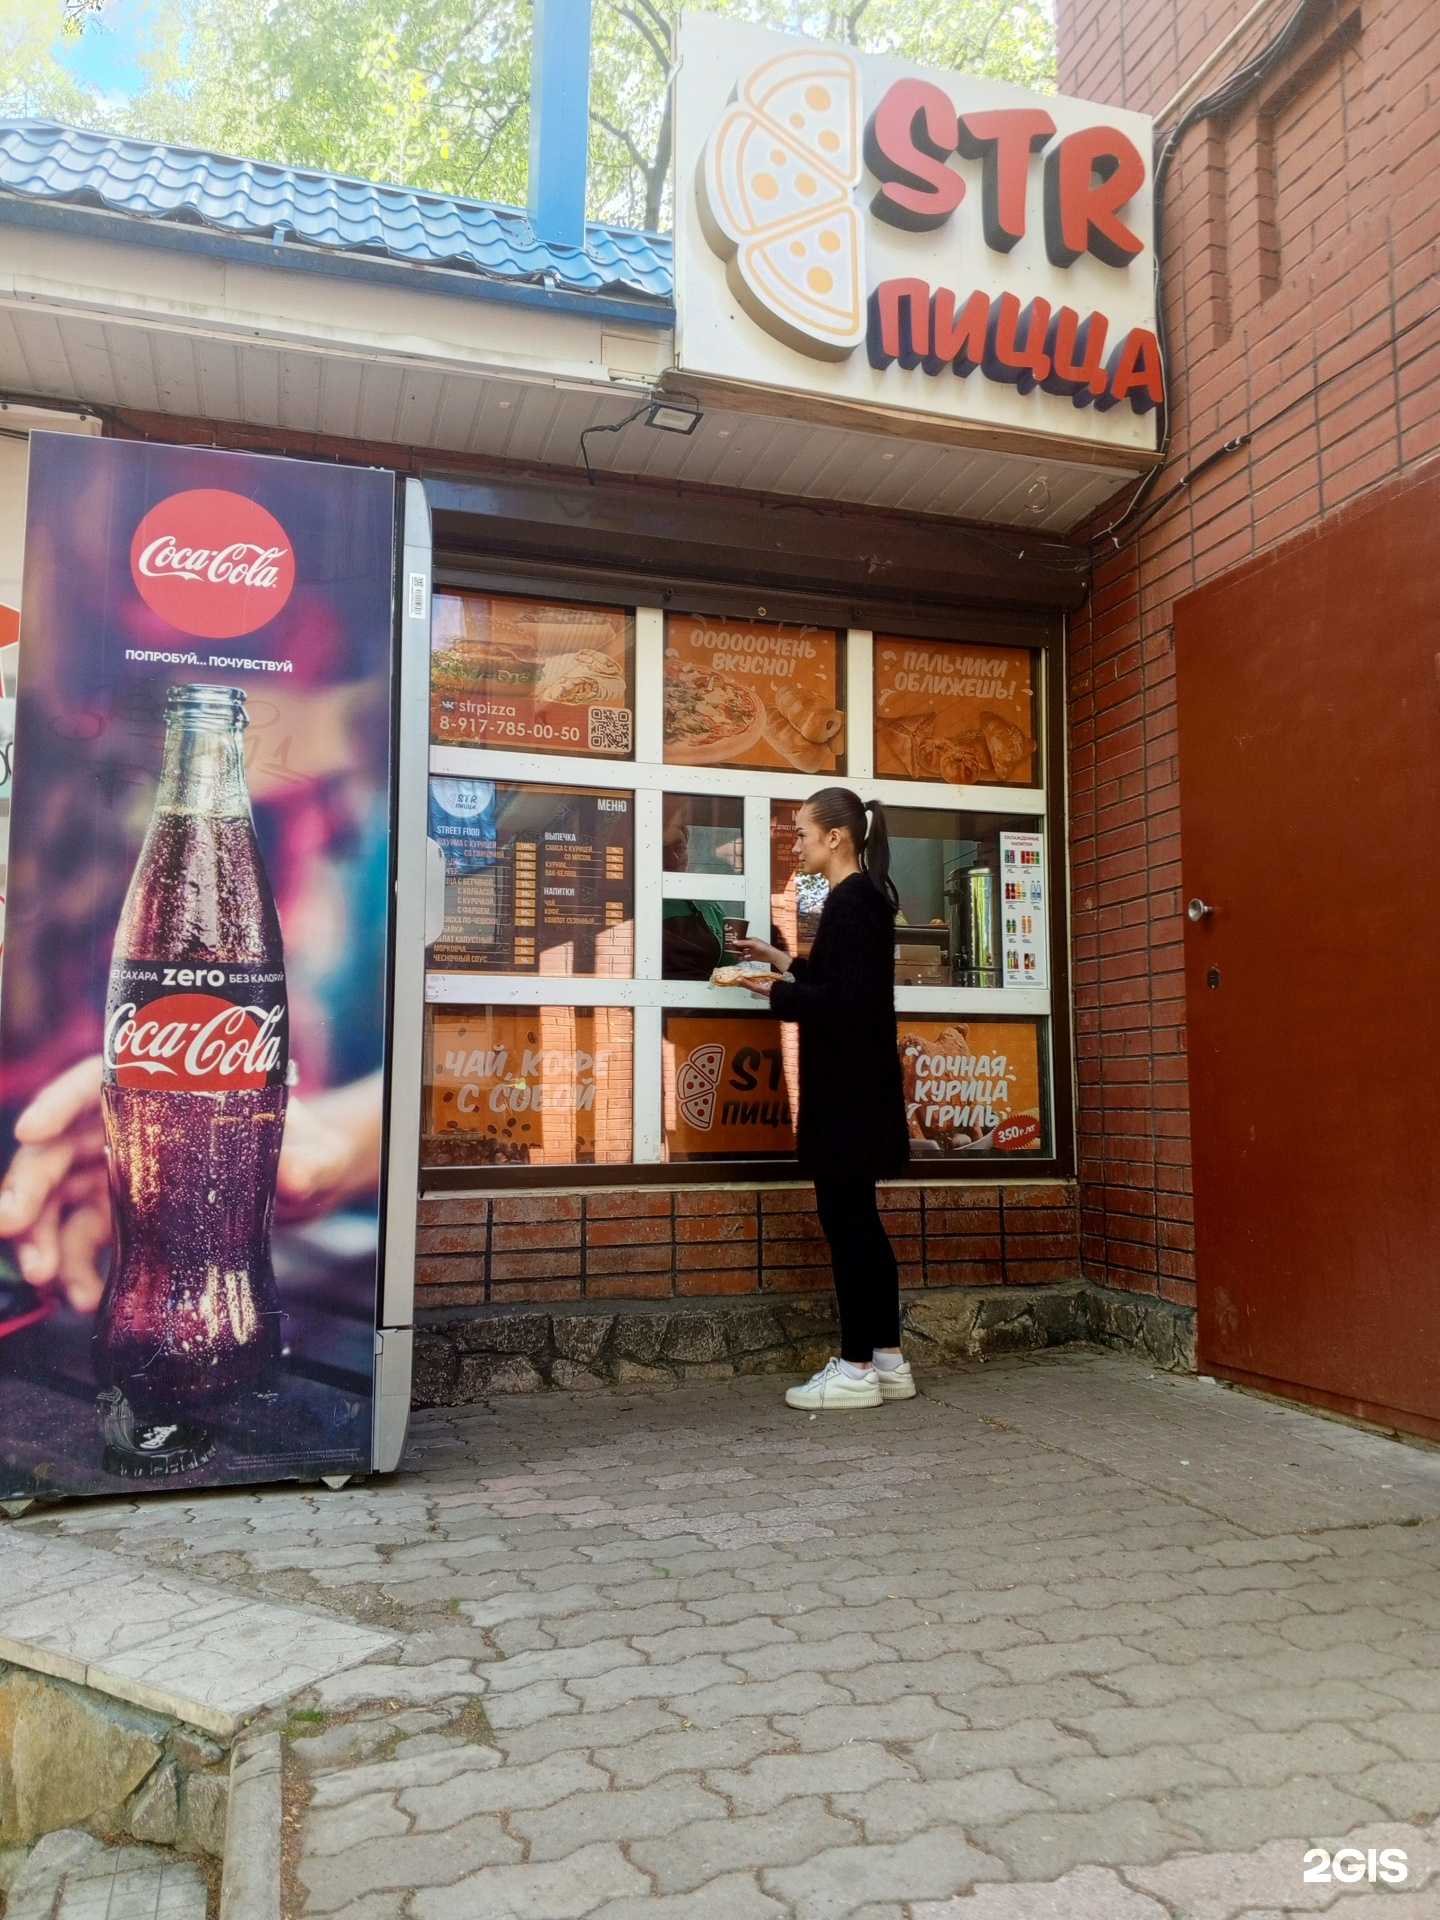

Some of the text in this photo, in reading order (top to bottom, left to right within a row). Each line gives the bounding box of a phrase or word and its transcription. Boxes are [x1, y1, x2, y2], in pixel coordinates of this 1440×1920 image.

[864, 77, 1146, 268] STR
[868, 277, 1164, 413] ПИЦЦА
[139, 535, 288, 588] Coca-Cola
[125, 649, 293, 673] ПОПРОБУЙ... ПОЧУВСТВУЙ
[712, 652, 796, 677] ВКУСНО!
[903, 650, 1008, 678] ПАЛЬЧИКИ
[895, 672, 1016, 700] ОБЛИЖЕШЬ!
[458, 701, 516, 717] strpizza
[440, 716, 580, 741] 8-917-785-00-50
[597, 799, 627, 813] МЕНЮ
[436, 825, 462, 835] STREET
[544, 832, 576, 842] ВЫПЕЧКА
[544, 887, 575, 896] НАПИТКИ
[161, 967, 226, 988] zero
[229, 973, 250, 984] БЕЗ
[103, 1003, 286, 1076] Coca-Cola
[445, 1044, 513, 1081] ЧАЙ,
[914, 1055, 1008, 1078] СОЧНАЯ
[457, 1084, 480, 1113] С
[914, 1079, 1009, 1104] КУРИЦА
[925, 1104, 1001, 1128] ГРИЛЬ
